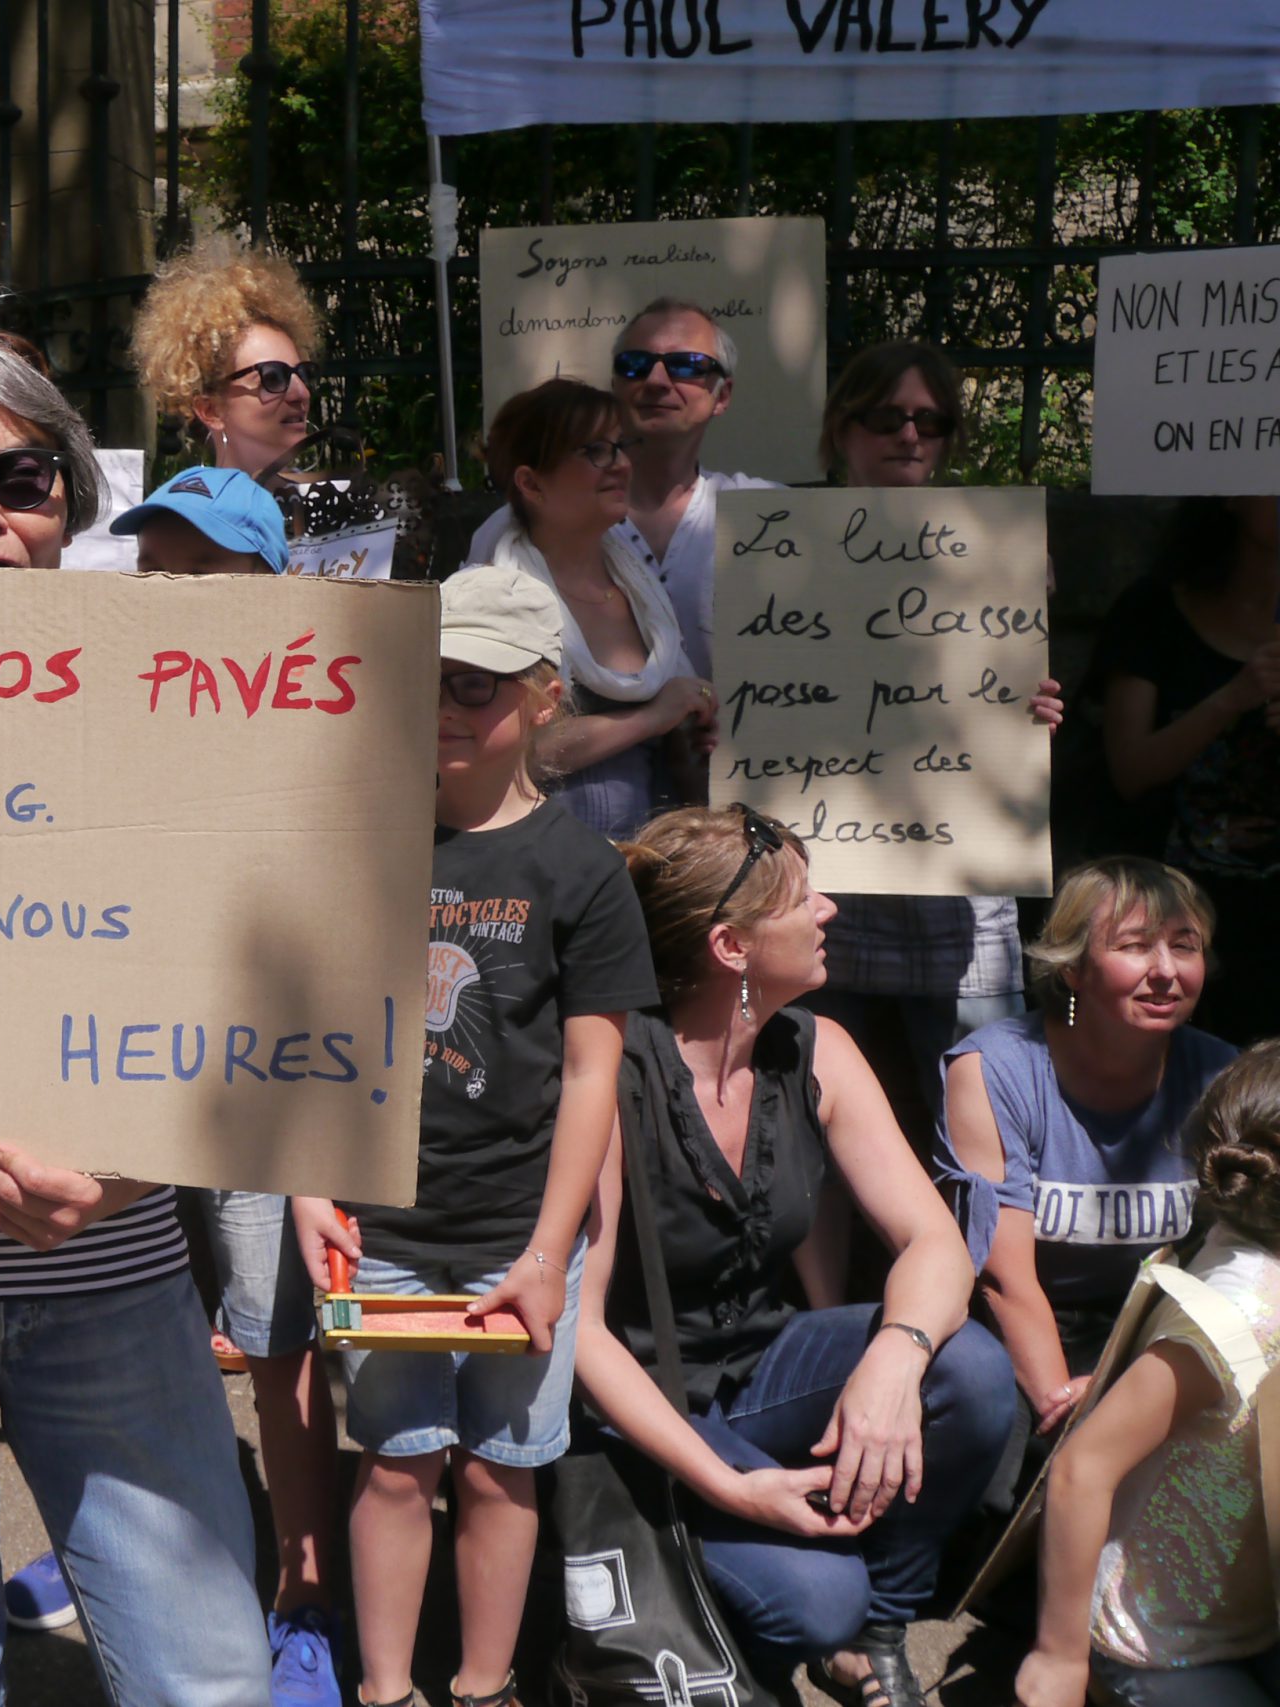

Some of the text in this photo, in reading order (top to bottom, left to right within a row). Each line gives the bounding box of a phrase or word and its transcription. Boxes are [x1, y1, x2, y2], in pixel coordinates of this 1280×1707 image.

[571, 0, 753, 58] PAUL
[516, 238, 608, 286] Soyons
[499, 307, 627, 337] demandons
[1113, 280, 1182, 333] NON
[1155, 350, 1200, 384] ET
[1207, 350, 1257, 384] LES
[1154, 421, 1194, 452] ON
[1209, 416, 1245, 451] EN
[733, 508, 969, 564] La lutte
[737, 587, 1050, 645] des classes
[138, 627, 364, 718] PAVÉS
[725, 667, 1024, 738] passe par le
[725, 743, 973, 794] respect des
[469, 921, 526, 945] VINTAGE
[440, 1047, 472, 1074] RIDE
[1096, 1187, 1196, 1240] TODAY
